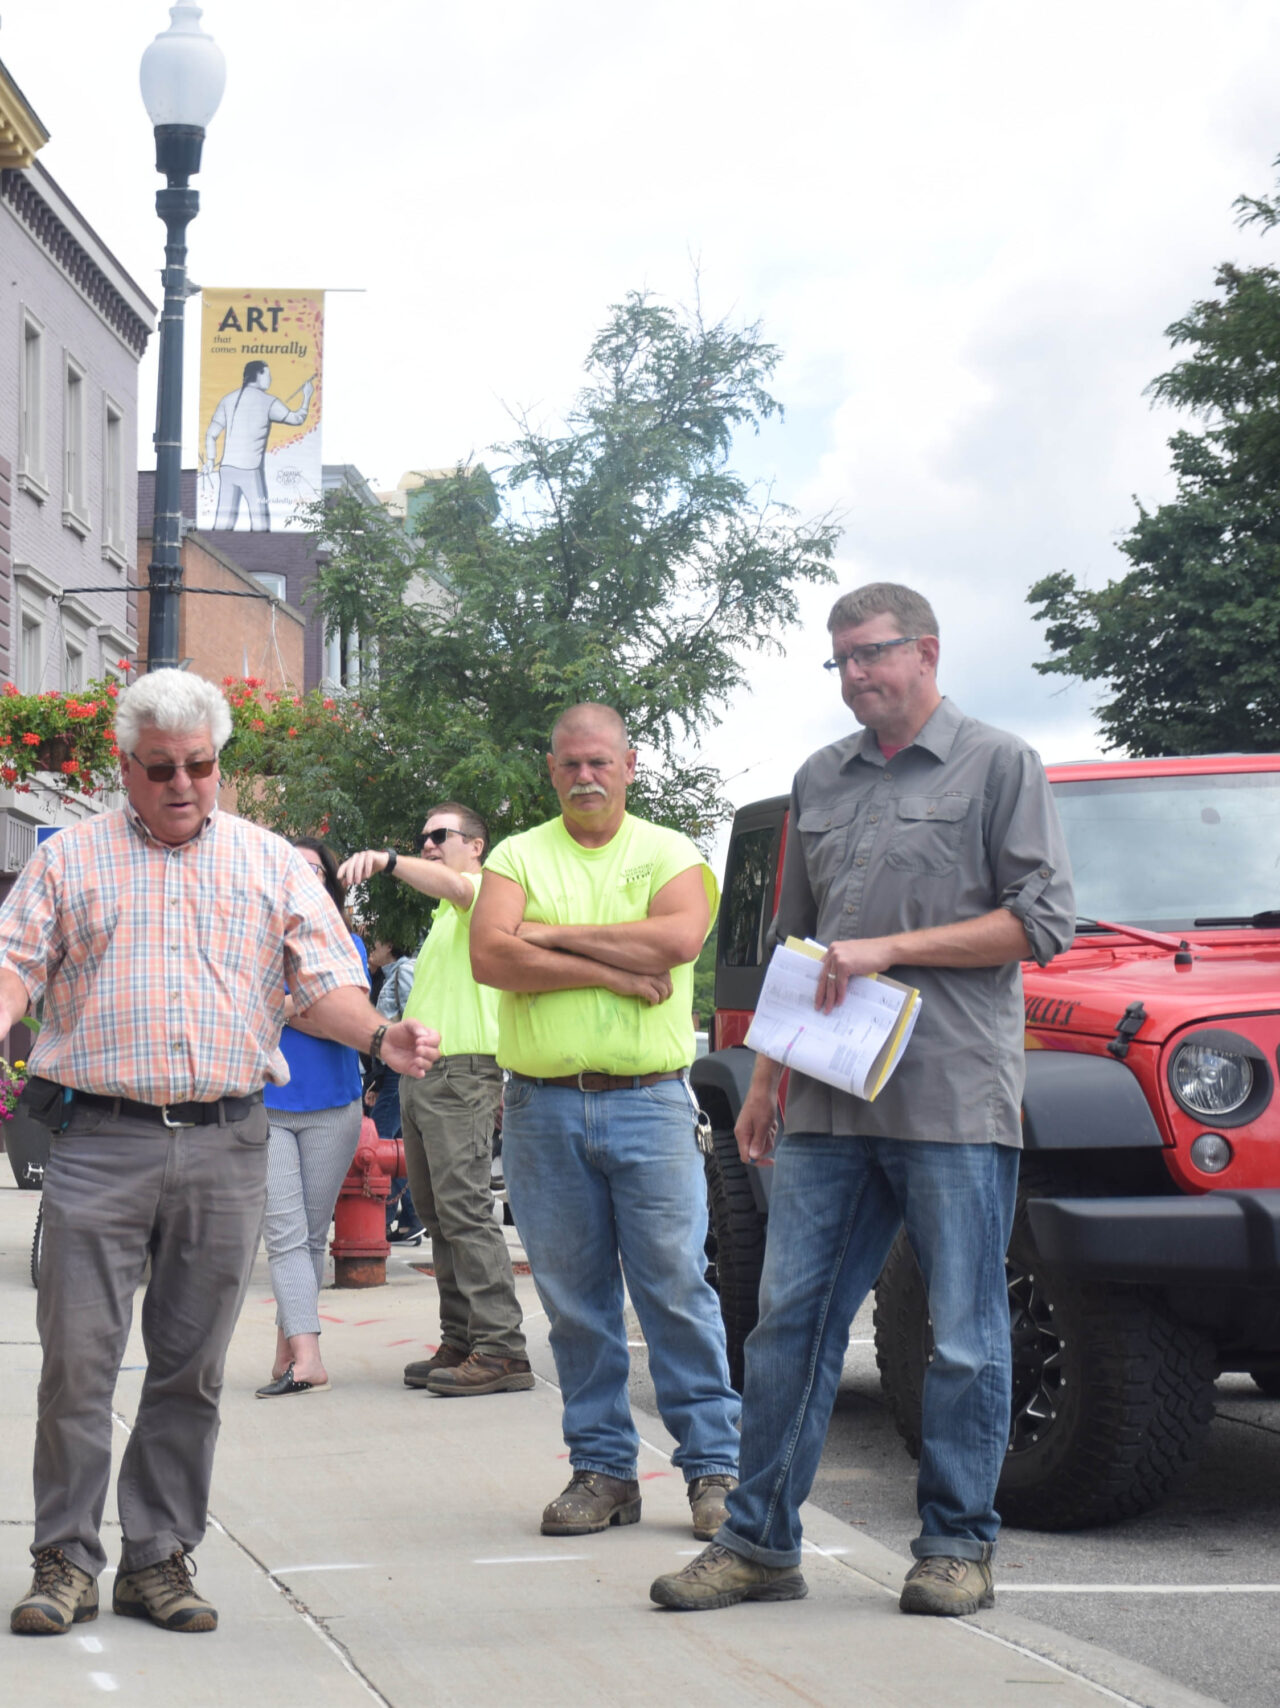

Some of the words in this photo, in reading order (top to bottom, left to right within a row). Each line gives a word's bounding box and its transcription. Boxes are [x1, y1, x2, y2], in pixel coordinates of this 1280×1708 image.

[218, 306, 284, 332] ART
[213, 335, 231, 343] that
[211, 346, 237, 354] comes
[240, 341, 308, 358] naturally
